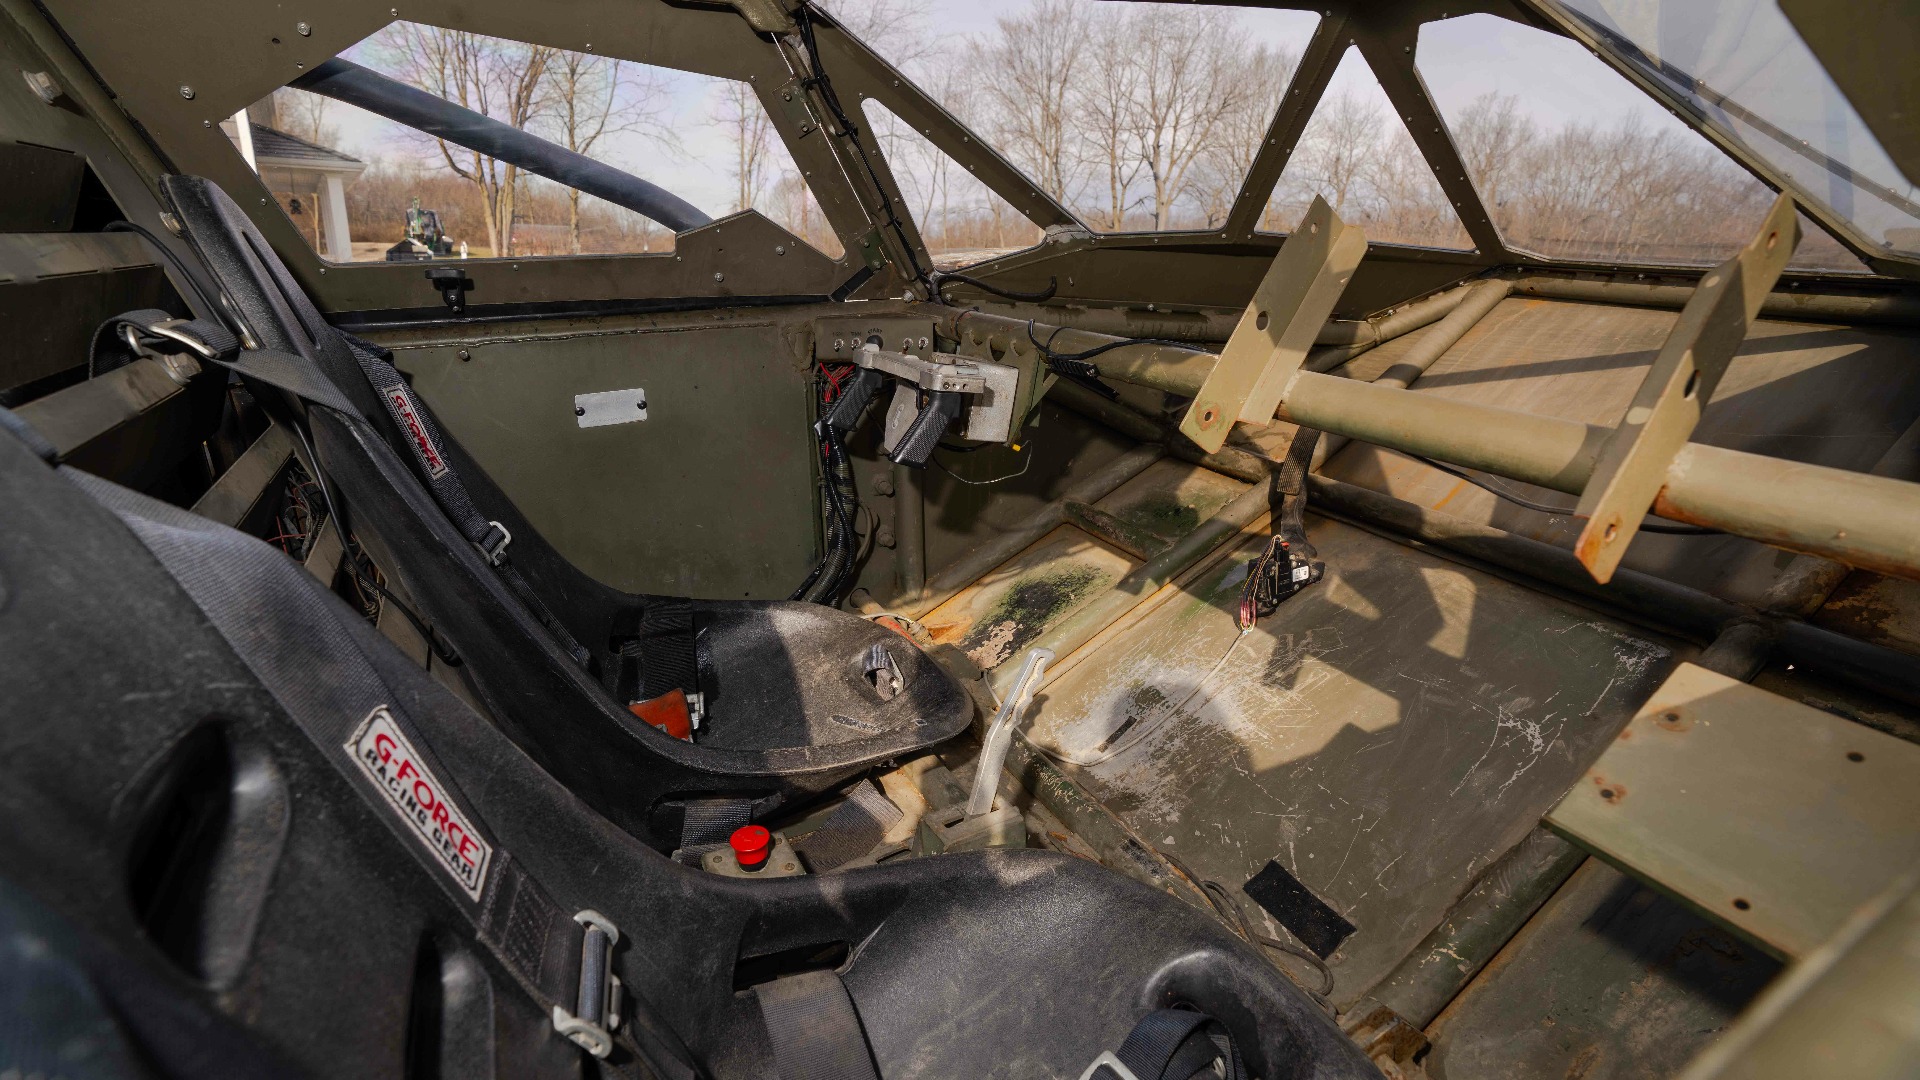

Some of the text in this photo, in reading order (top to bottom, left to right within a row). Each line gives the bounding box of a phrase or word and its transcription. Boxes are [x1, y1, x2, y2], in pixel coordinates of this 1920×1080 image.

[395, 395, 441, 468] G-FORCE
[365, 748, 474, 881] RACING GEAR
[375, 733, 479, 867] G-FORCE
